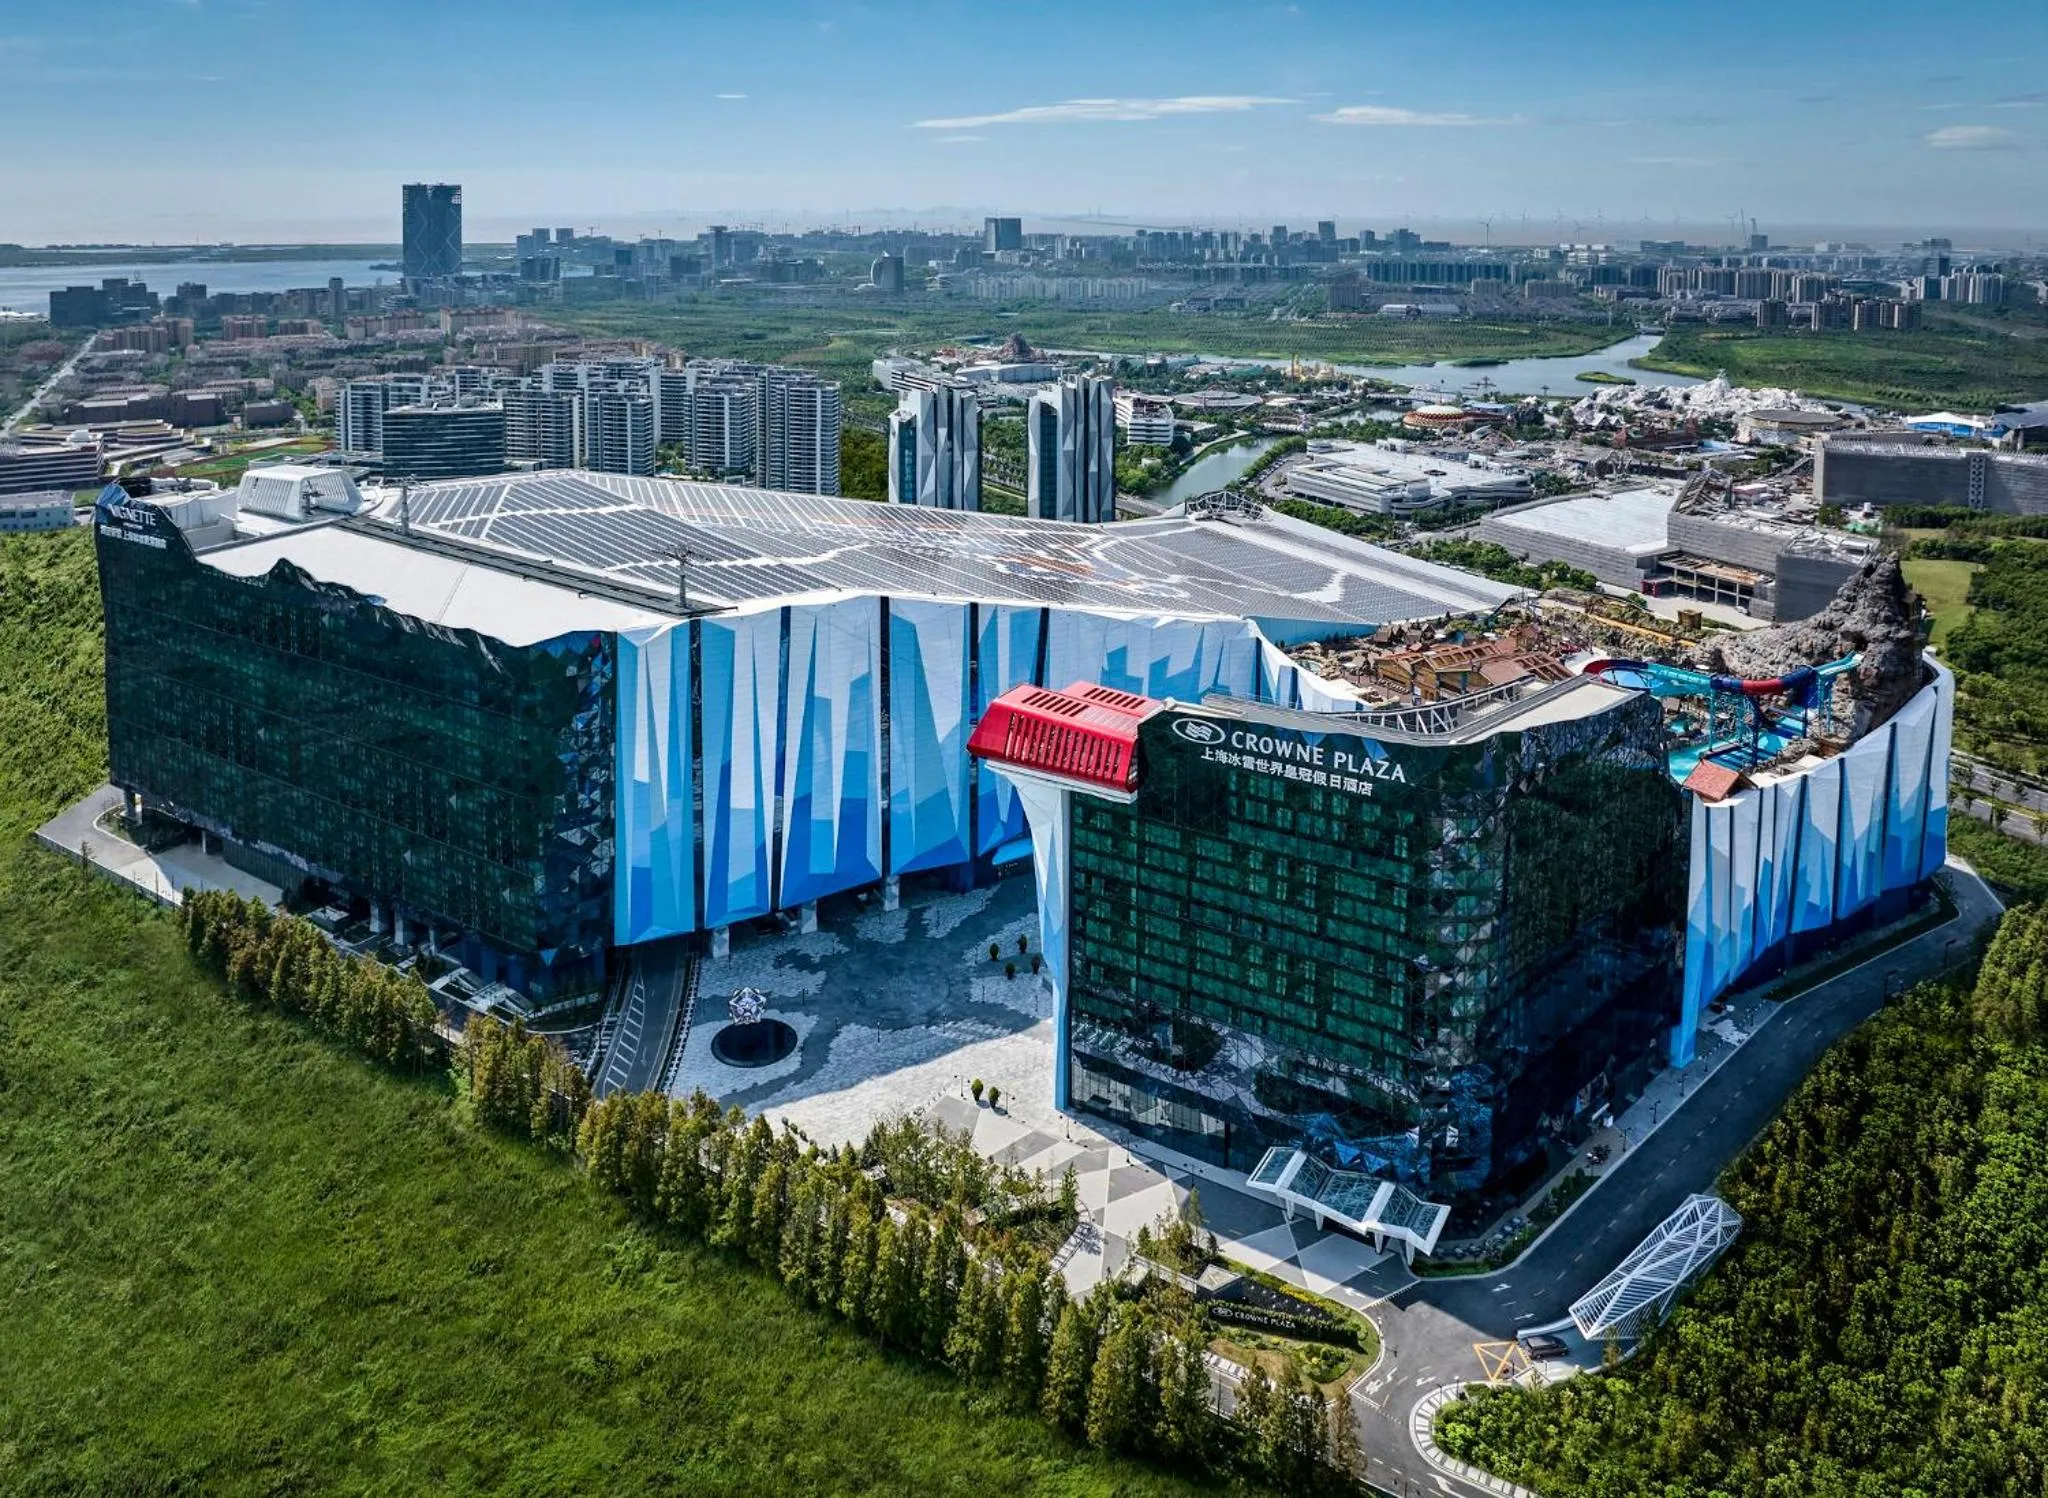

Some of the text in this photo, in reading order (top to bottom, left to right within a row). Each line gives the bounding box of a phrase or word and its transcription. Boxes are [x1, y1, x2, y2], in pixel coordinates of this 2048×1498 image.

[1201, 746, 1374, 797] 上海冰雪世界皇冠假日酒店
[1231, 731, 1406, 783] CROWNE PLAZA
[1234, 1311, 1296, 1329] CROWNE PLAZA
